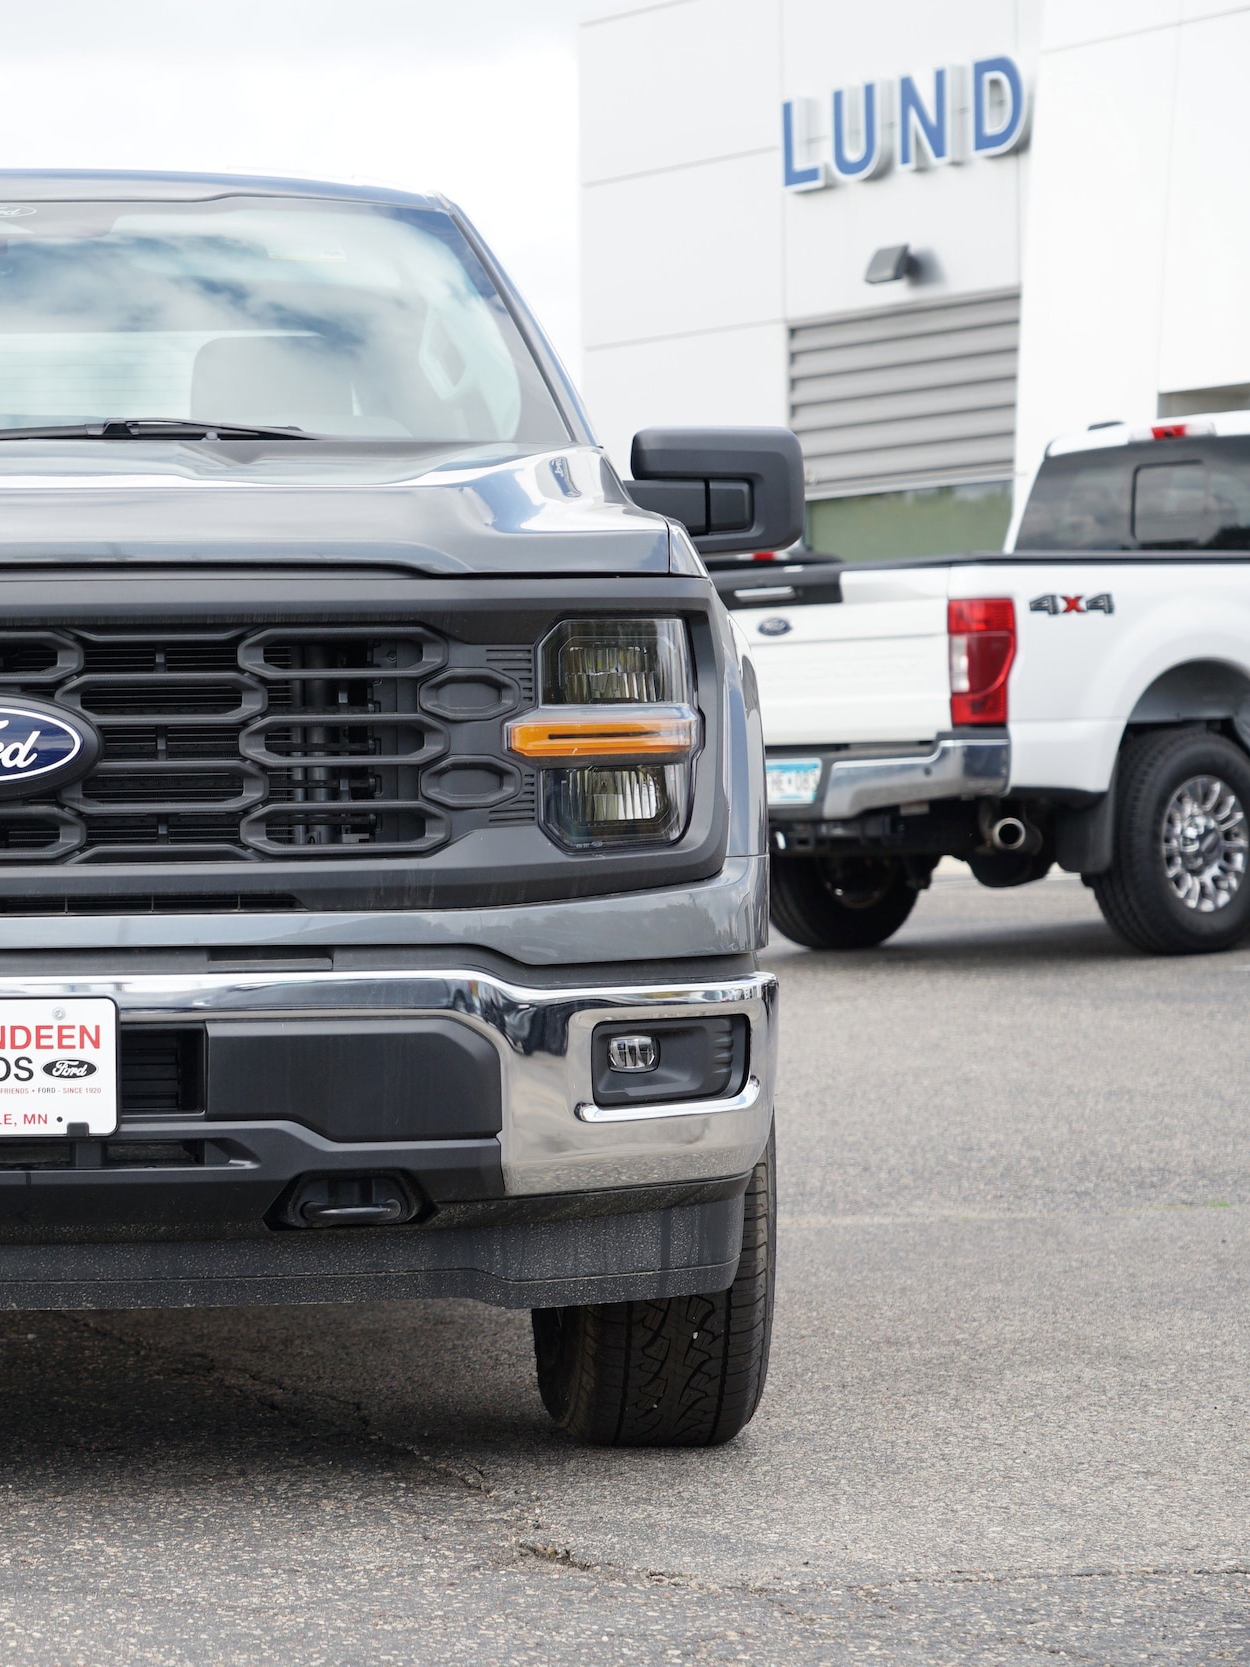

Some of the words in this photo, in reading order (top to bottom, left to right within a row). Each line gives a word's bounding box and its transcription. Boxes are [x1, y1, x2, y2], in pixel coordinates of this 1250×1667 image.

[782, 54, 1025, 187] LUND
[51, 1060, 88, 1076] Ford
[0, 1087, 30, 1095] FRIENDS
[23, 1113, 48, 1126] MN
